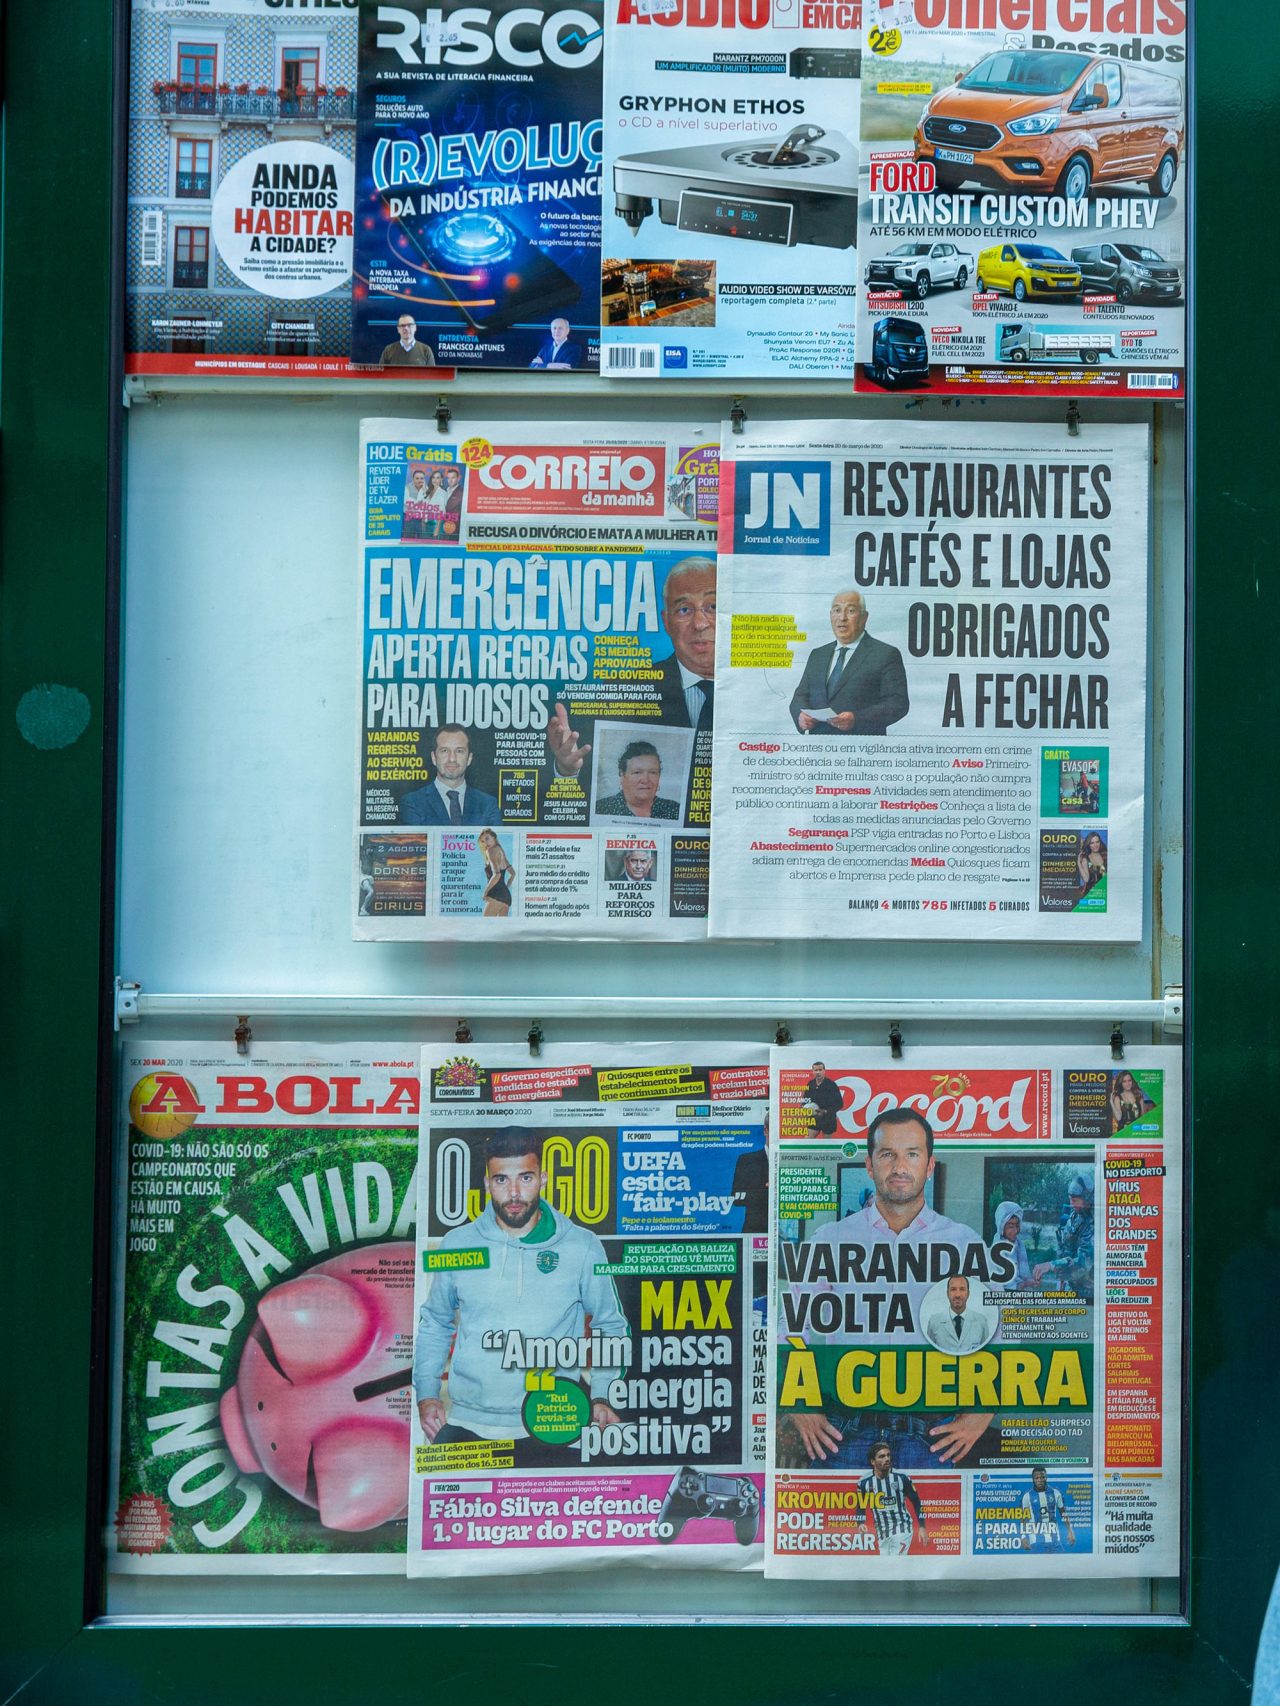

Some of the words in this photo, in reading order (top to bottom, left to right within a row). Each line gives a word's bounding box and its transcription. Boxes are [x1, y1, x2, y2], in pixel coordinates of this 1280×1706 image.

[377, 7, 604, 68] RISCO
[488, 74, 533, 82] FINANCEIRA
[619, 95, 728, 114] GRYPHON
[733, 98, 805, 115] ETHOS
[253, 163, 337, 190] AINDA
[869, 161, 936, 195] FORD
[250, 191, 337, 209] PODEMOS
[390, 198, 415, 218] DA
[420, 187, 522, 215] INDÚSTRIA
[869, 194, 974, 226] TRANSIT
[980, 197, 1091, 228] CUSTOM
[1095, 199, 1159, 230] PHEV
[234, 209, 353, 236] HABITAR
[870, 226, 889, 238] ATÉ
[892, 228, 904, 238] 56
[907, 228, 924, 238] KM
[927, 228, 942, 238] EM
[946, 228, 980, 238] MODO
[984, 226, 1037, 239] ELÉTRICO
[250, 237, 262, 253] A
[265, 237, 336, 254] CIDADE?
[369, 445, 403, 460] HOJE
[406, 446, 453, 462] Grátis
[462, 447, 491, 463] 124
[479, 454, 656, 490] CORREIO
[582, 491, 598, 506] da
[600, 492, 655, 507] manhã
[743, 472, 820, 530] JN
[842, 461, 1111, 519] RESTAURANTES
[744, 535, 770, 544] Jornal
[772, 536, 783, 544] de
[785, 536, 820, 545] Notícias
[854, 521, 961, 588] CAFÉS
[973, 534, 991, 588] E
[1002, 534, 1111, 589] LOJAS
[368, 554, 659, 632] EMERGÊNCIA
[908, 602, 1110, 659] OBRIGADOS
[367, 633, 472, 680] APERTA
[479, 634, 589, 681] REGRAS
[366, 684, 439, 729] PARA
[446, 684, 549, 729] IDOSOS
[942, 673, 963, 728] A
[975, 673, 1109, 730] FECHAR
[441, 839, 476, 852] Jovic
[606, 840, 656, 849] BENFICA
[788, 828, 848, 840] Segurança
[851, 828, 870, 838] PSP
[872, 828, 896, 841] vigia
[898, 829, 942, 839] entradas
[945, 831, 958, 839] no
[960, 829, 988, 840] Porto
[989, 832, 996, 840] e
[998, 830, 1030, 840] Lisboa
[849, 899, 879, 912] BALANÇO
[881, 900, 889, 910] 4
[892, 900, 920, 910] MORTOS
[922, 900, 948, 910] 785
[950, 900, 986, 911] INFETADOS
[988, 901, 997, 911] 5
[999, 901, 1030, 911] CURADOS
[141, 1076, 206, 1113] A
[216, 1075, 420, 1115] BOLA
[622, 1152, 685, 1172] UEFA
[622, 1169, 690, 1192] estica
[622, 1190, 746, 1216] “fair-play”
[211, 1206, 292, 1290] À
[277, 1161, 417, 1254] VIDA
[429, 1253, 484, 1267] ENTREVISTA
[782, 1241, 1016, 1283] VARANDAS
[641, 1280, 732, 1330] MAX
[781, 1293, 915, 1336] VOLTA
[482, 1328, 632, 1369] “Amorim
[641, 1333, 732, 1372] passa
[779, 1339, 823, 1407] À
[836, 1350, 1087, 1407] GUERRA
[146, 1249, 262, 1548] CONTAS
[608, 1369, 732, 1419] energia
[580, 1416, 731, 1462] positiva”
[429, 1497, 497, 1519] Fábio
[501, 1497, 559, 1517] Silva
[563, 1495, 661, 1516] defende
[777, 1491, 884, 1510] KROVINOVIC
[975, 1507, 1032, 1520] MBEMBA
[467, 1522, 532, 1545] lugar
[537, 1522, 567, 1540] do
[571, 1521, 602, 1539] FC
[606, 1520, 674, 1539] Porto
[777, 1512, 823, 1530] PODE
[777, 1532, 875, 1551] REGRESSAR
